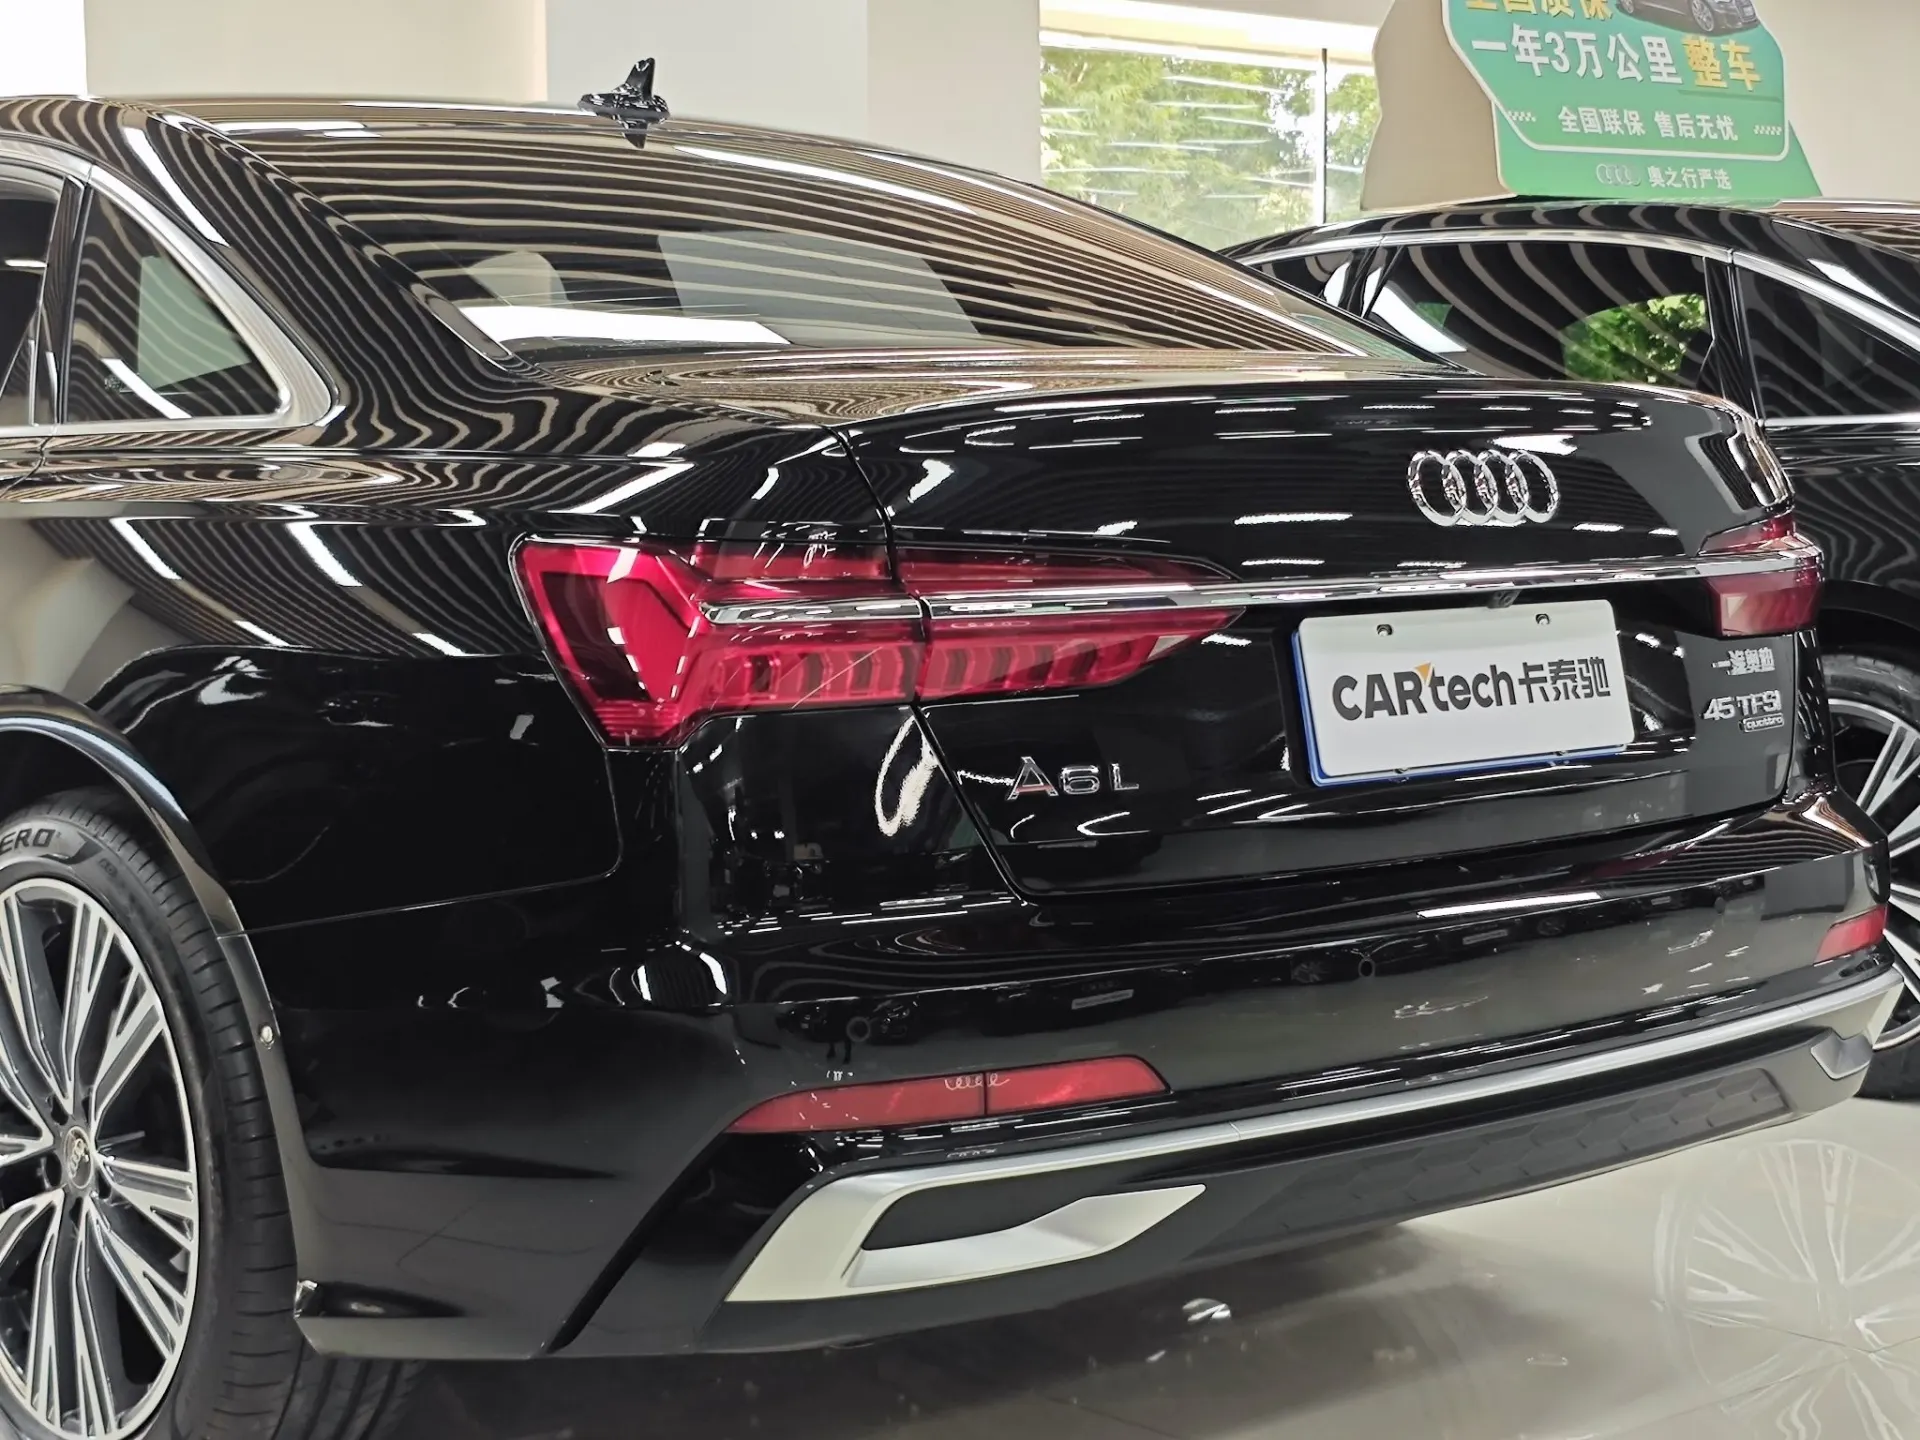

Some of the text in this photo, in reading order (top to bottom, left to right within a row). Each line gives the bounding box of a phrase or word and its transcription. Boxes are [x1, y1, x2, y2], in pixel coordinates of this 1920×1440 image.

[1471, 24, 1762, 92] 一年3万公里 整车
[1558, 106, 1739, 141] 全国联保 售后无忧
[1647, 165, 1732, 190] 奥之行严选
[1703, 689, 1783, 721] 45 TFSI
[1745, 716, 1783, 730] quattro
[1006, 756, 1140, 800] A6L
